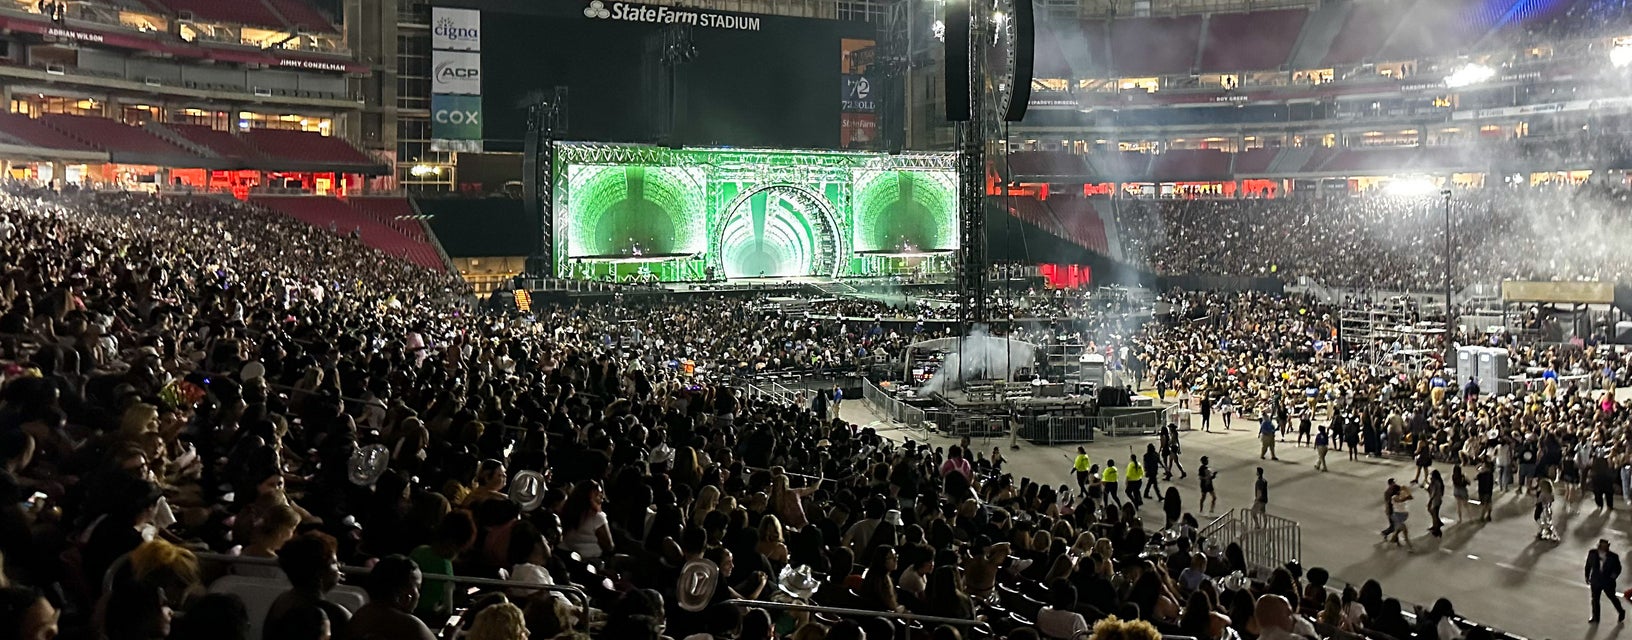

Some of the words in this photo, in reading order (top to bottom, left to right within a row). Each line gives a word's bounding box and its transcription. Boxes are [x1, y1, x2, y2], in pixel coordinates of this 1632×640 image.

[700, 13, 760, 31] STADIUM
[48, 28, 76, 38] ADRIAN
[76, 32, 103, 42] WILSON
[434, 23, 478, 40] cigna
[280, 59, 302, 67] JIMMY
[303, 61, 346, 71] CONZELMAN
[442, 67, 479, 78] ACP
[436, 110, 479, 125] COX
